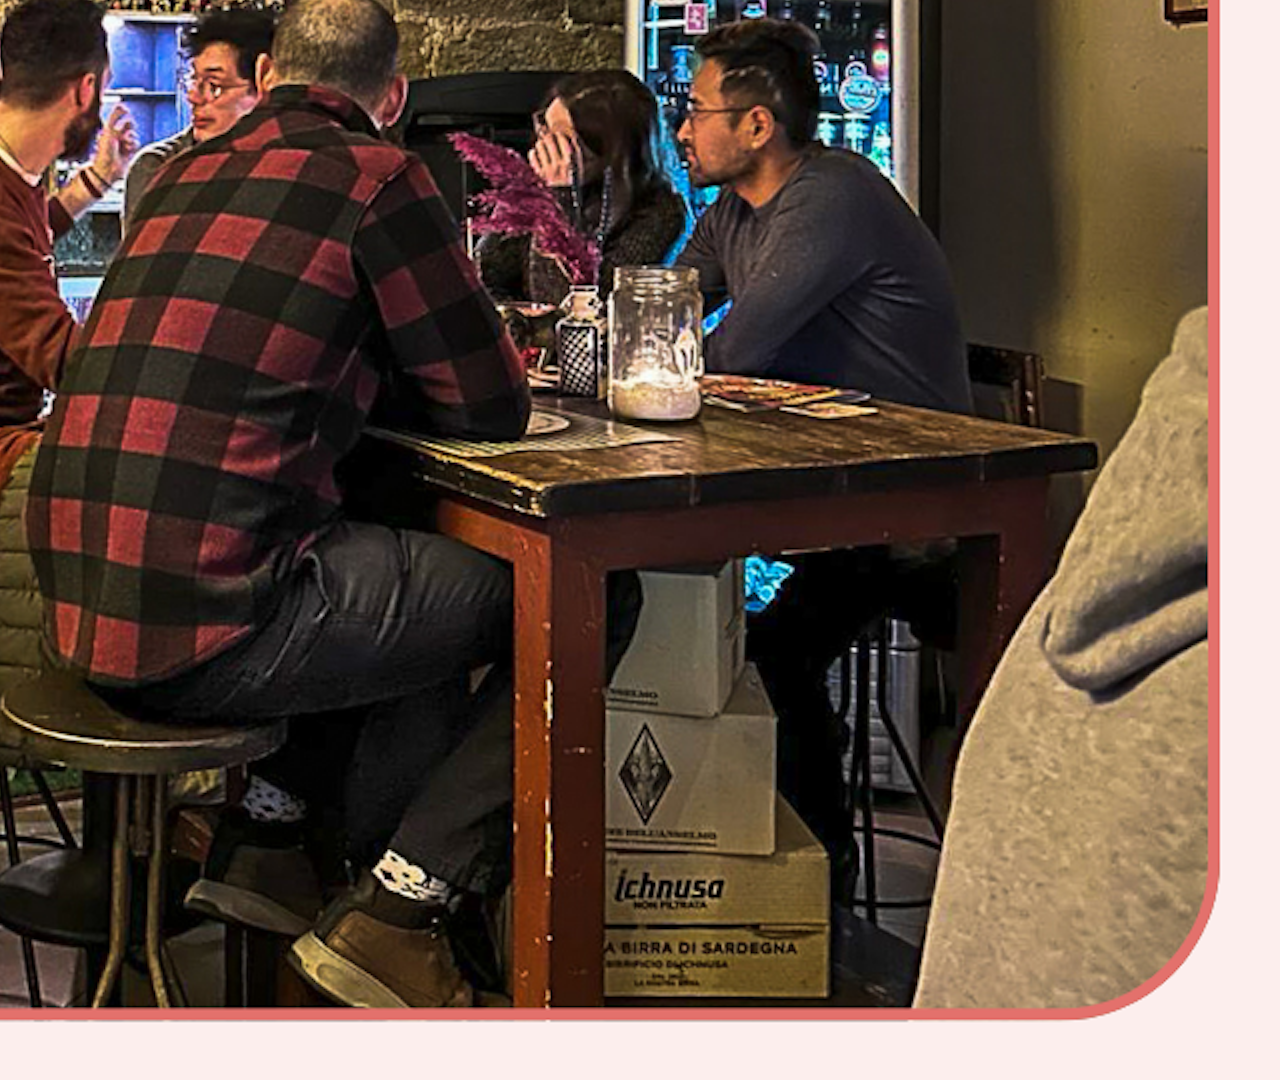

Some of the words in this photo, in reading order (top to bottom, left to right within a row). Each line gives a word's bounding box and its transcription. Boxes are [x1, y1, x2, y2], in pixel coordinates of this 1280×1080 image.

[633, 901, 657, 910] NON
[660, 901, 707, 909] FILTRATA
[622, 942, 673, 954] BIRRA
[678, 942, 696, 954] DI
[701, 941, 798, 955] SARDEGNA
